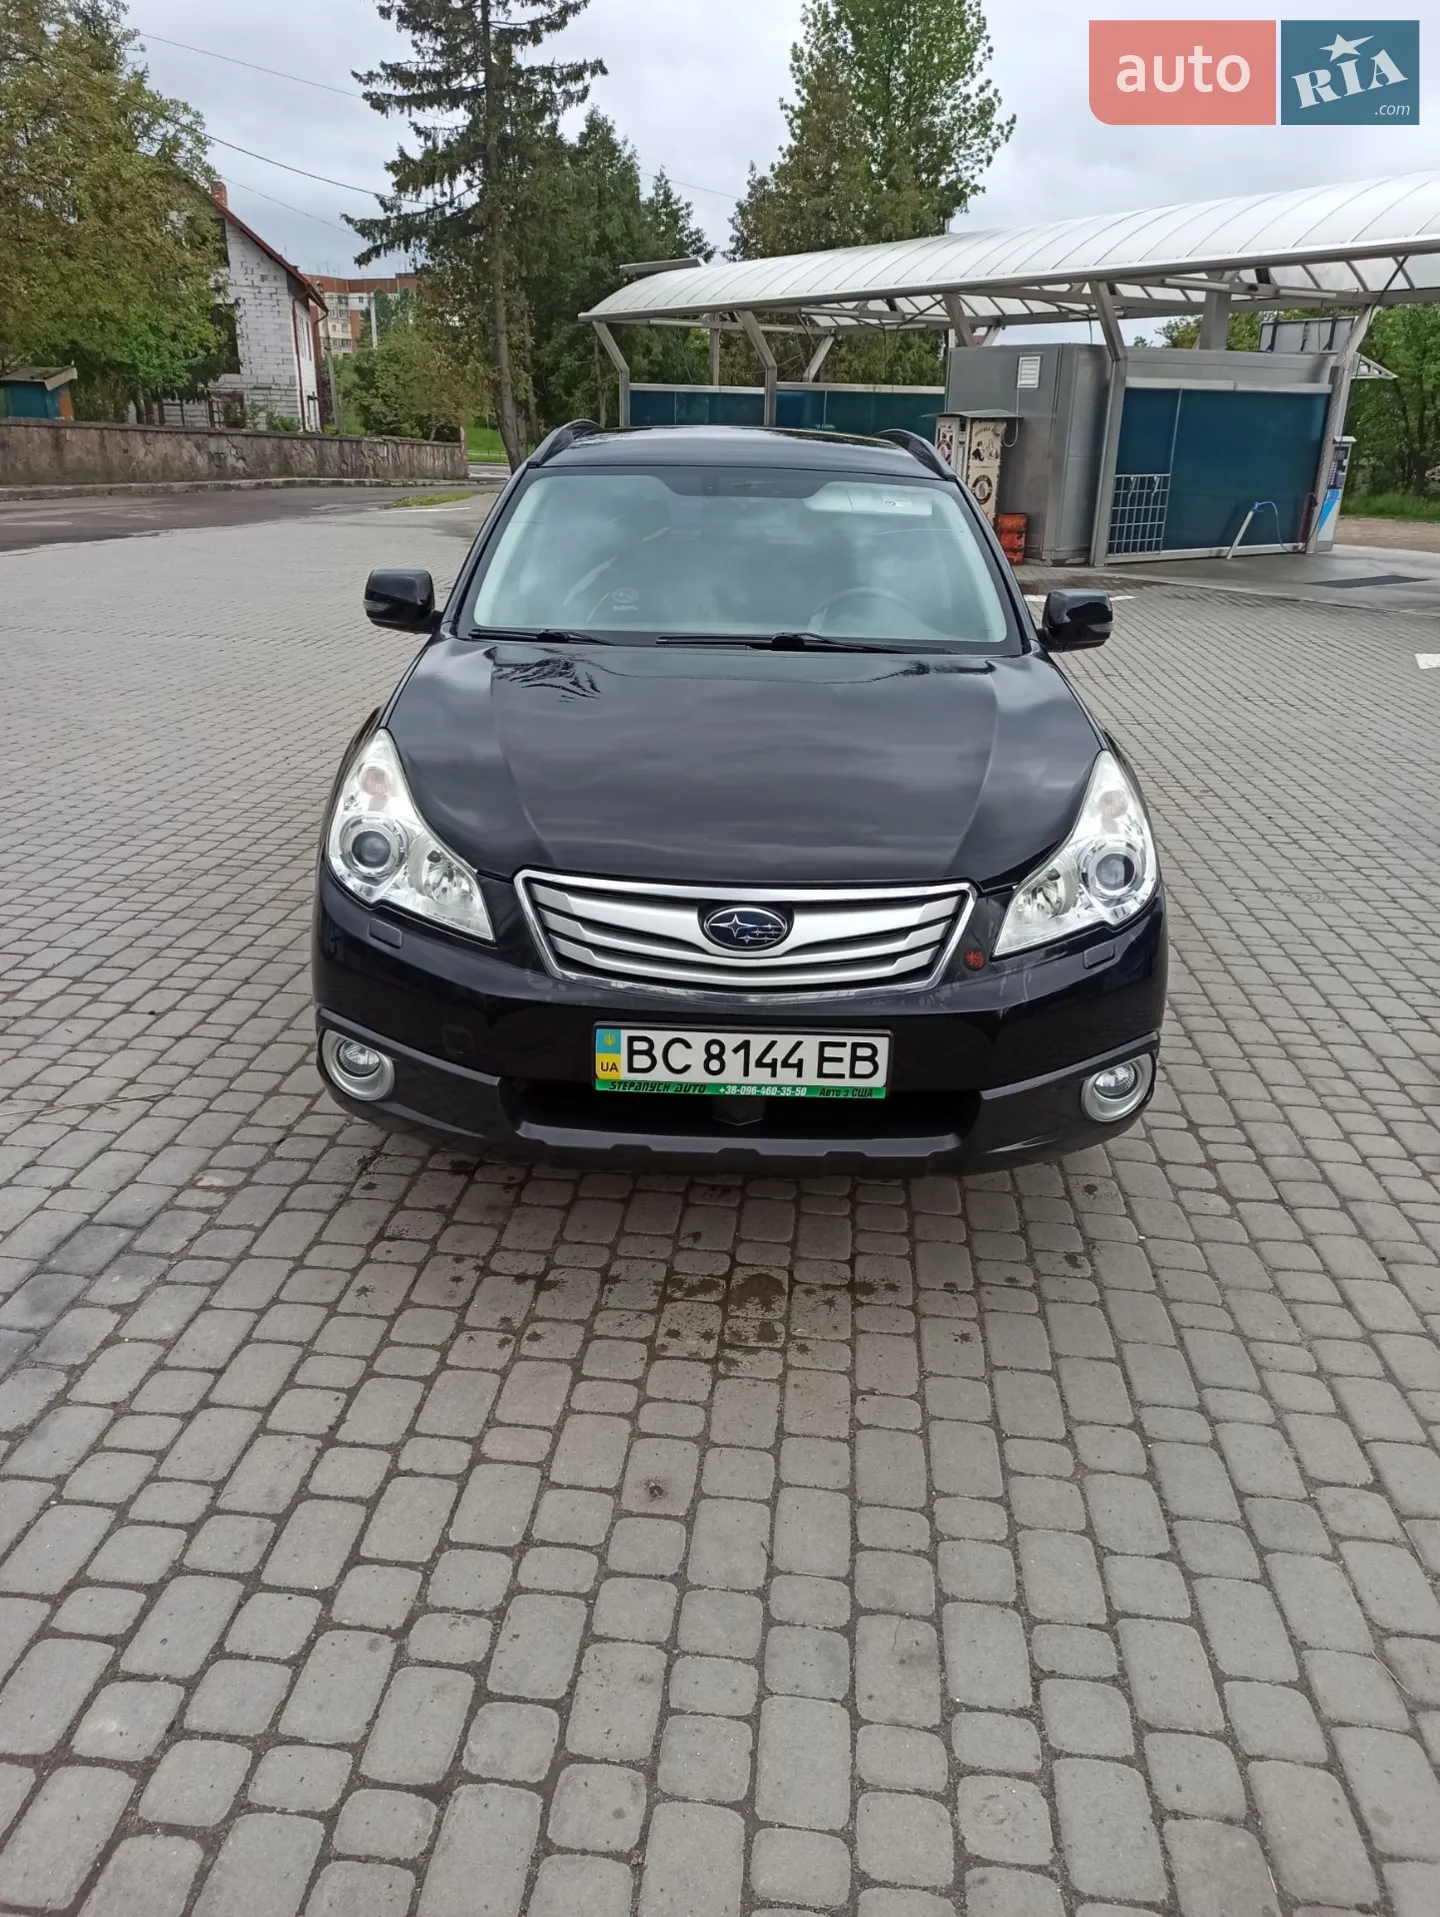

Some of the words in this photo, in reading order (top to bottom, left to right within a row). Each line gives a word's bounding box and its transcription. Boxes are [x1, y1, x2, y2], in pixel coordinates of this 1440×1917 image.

[626, 1035, 692, 1075] BC
[703, 1038, 804, 1078] 8144
[816, 1041, 879, 1079] EB
[600, 1062, 619, 1073] UA
[719, 1085, 807, 1097] +38-096-460-35-50
